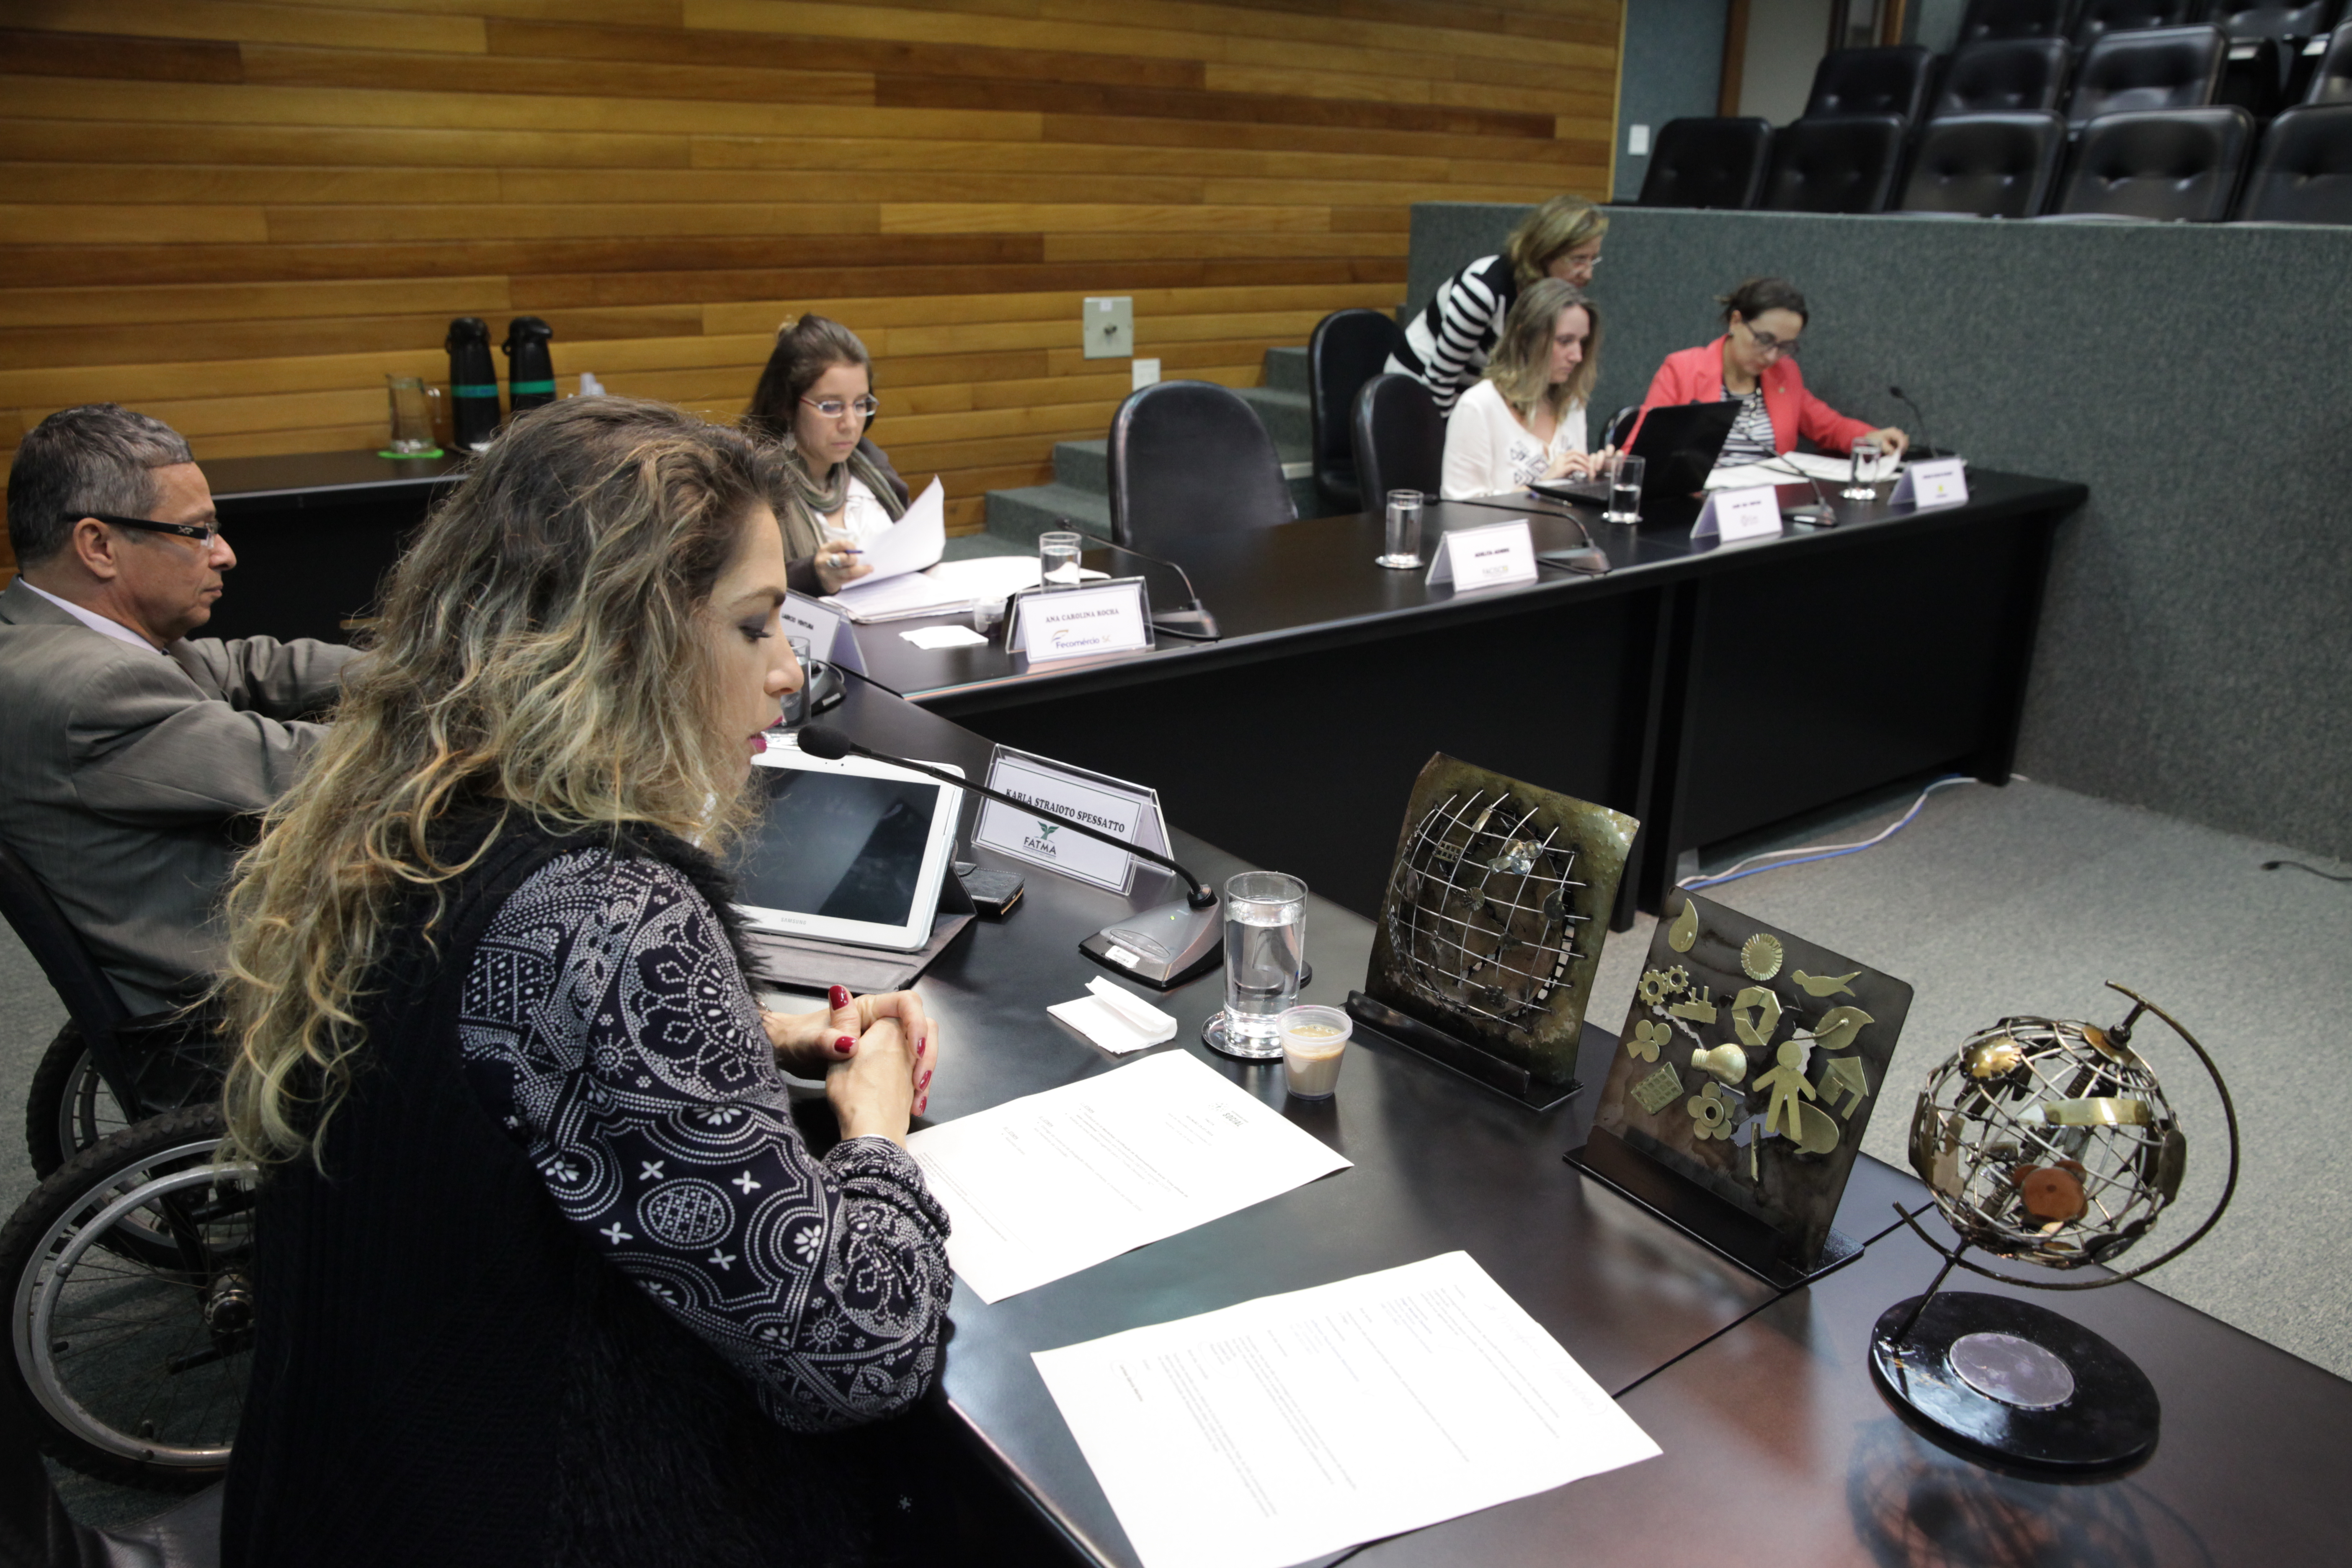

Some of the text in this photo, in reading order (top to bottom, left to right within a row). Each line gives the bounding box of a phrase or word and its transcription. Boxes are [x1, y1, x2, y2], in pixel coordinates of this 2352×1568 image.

[1062, 611, 1095, 621] CAROLINA
[1056, 639, 1100, 649] Fecomércio
[1006, 789, 1125, 833] KARLA STRAIOTO SPESSATTO
[1024, 836, 1056, 855] FATMA
[1222, 1112, 1245, 1127] SOCIAL
